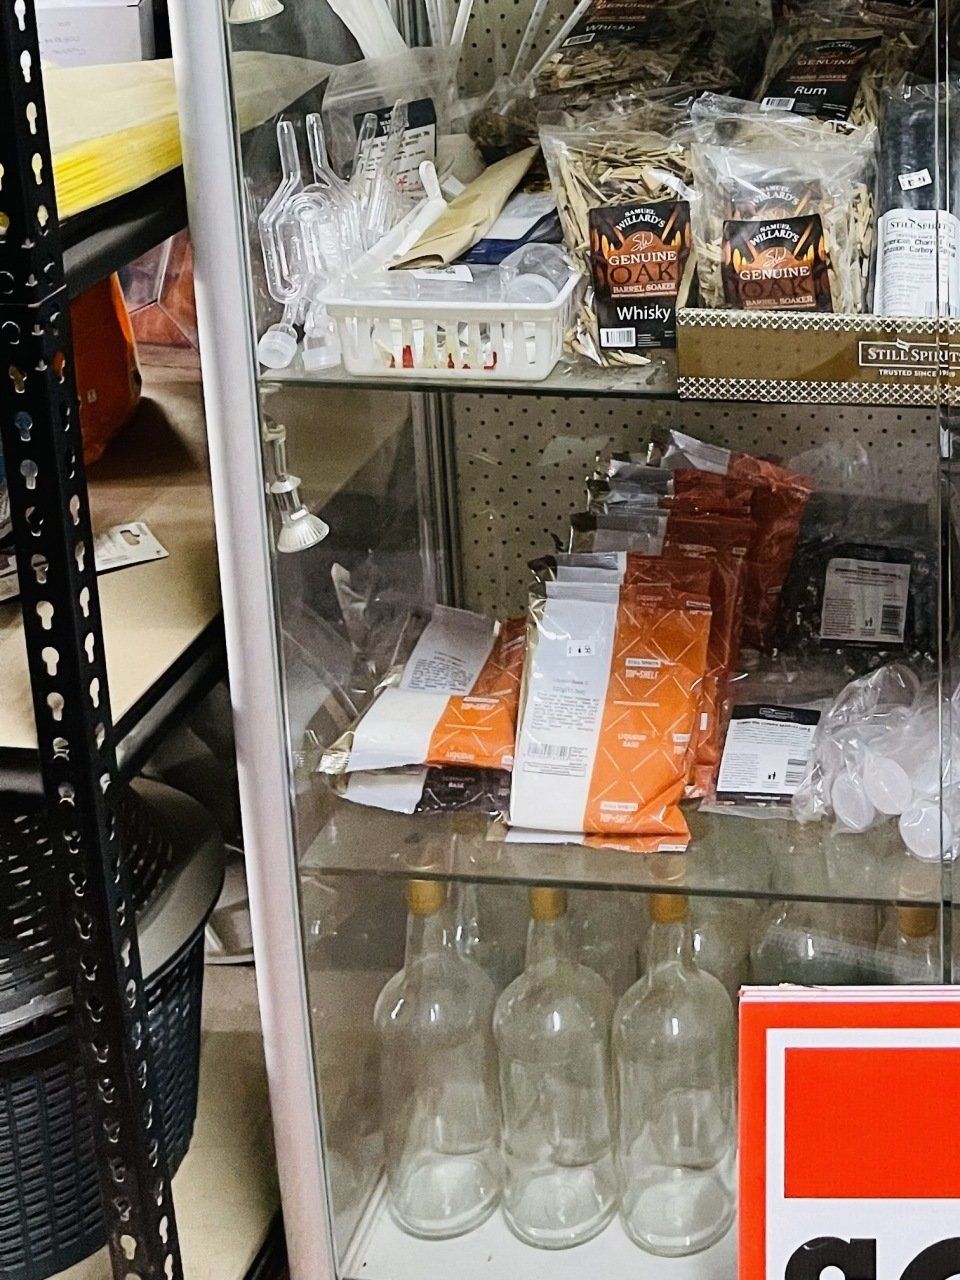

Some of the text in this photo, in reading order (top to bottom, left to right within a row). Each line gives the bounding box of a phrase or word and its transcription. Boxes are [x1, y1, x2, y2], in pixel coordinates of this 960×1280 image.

[794, 86, 827, 95] Rum
[624, 208, 656, 219] SAMUEL
[615, 214, 665, 231] WILLARD'S
[759, 224, 791, 233] SAMUEL
[750, 230, 799, 247] WILLARD'S
[608, 251, 677, 266] GENUINE
[609, 261, 677, 284] OAK
[739, 266, 810, 281] GENUINE
[613, 282, 676, 293] BARREL SOAKER
[741, 277, 813, 297] OAK
[745, 295, 814, 307] BARREL SOAKER
[616, 305, 671, 323] Whisky
[867, 347, 909, 361] STILL
[879, 369, 912, 377] TRUSTED
